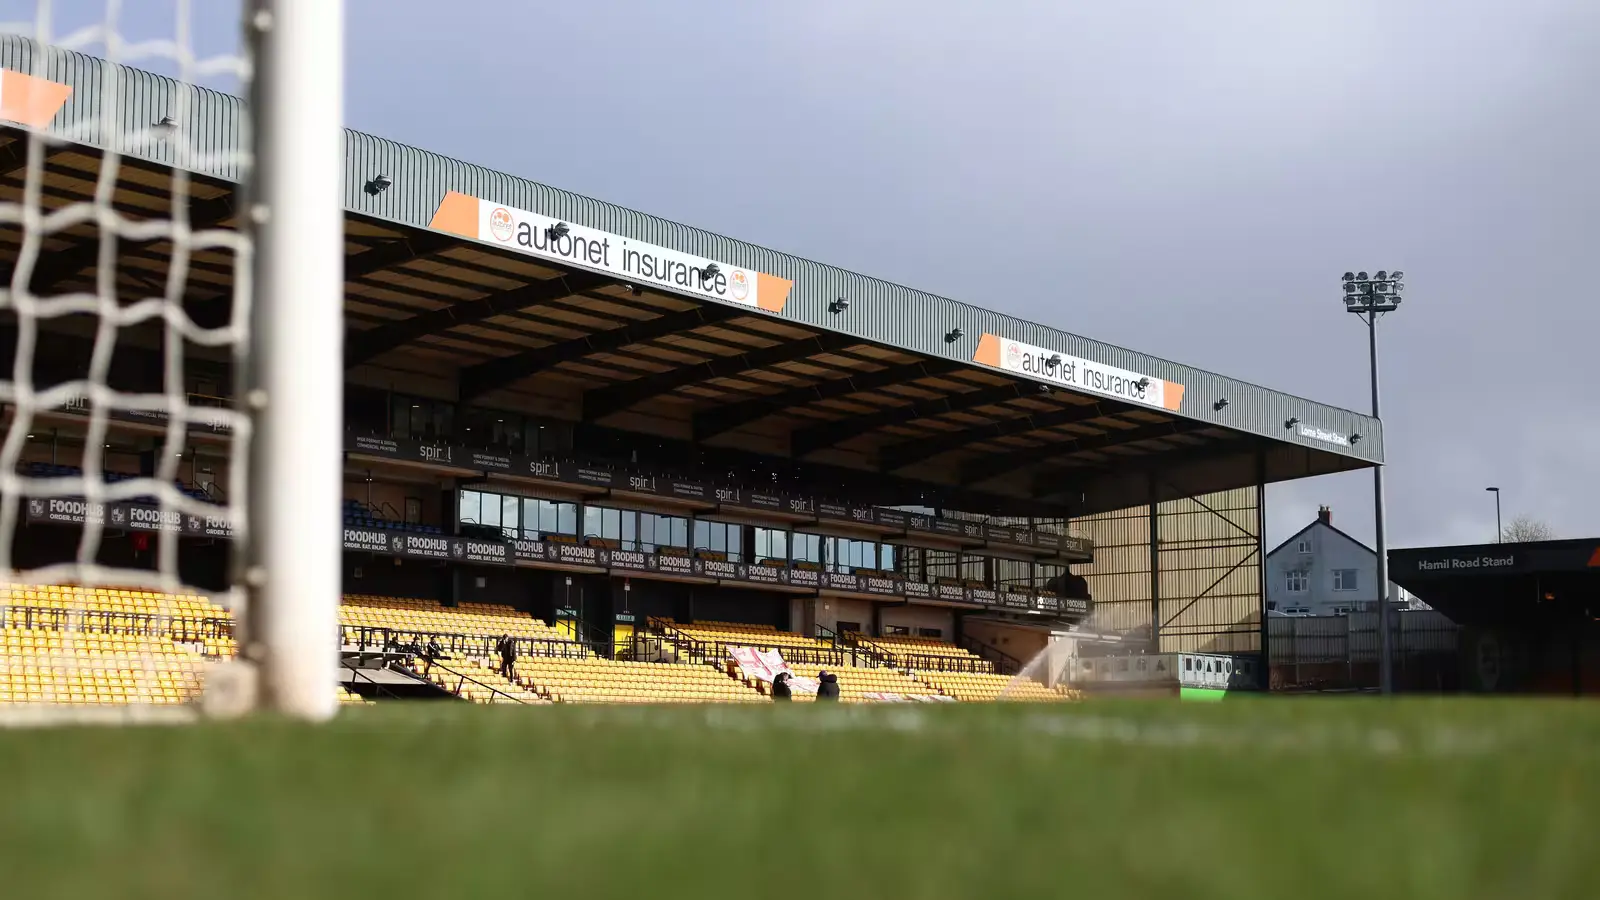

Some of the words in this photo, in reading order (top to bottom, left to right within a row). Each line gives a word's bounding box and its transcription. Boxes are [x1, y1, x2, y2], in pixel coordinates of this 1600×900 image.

[517, 221, 610, 266] autonet
[623, 241, 726, 294] insurance
[1022, 352, 1076, 383] autonet
[1084, 362, 1145, 399] insurance
[420, 444, 452, 460] spirl
[530, 460, 559, 476] spirl
[630, 475, 656, 490] spirl
[716, 488, 740, 501] spirl
[790, 496, 814, 512] spirl
[852, 508, 874, 520] spirl
[910, 516, 930, 528] spirl
[344, 530, 387, 544] FOODHUB
[408, 536, 448, 550] FOODHUB
[467, 542, 505, 556] FOODHUB
[561, 545, 595, 558] FOODHUB
[612, 550, 644, 564] FOODHUB
[660, 555, 690, 568] FOODHUB
[1418, 559, 1450, 570] Hamil
[1452, 557, 1480, 568] Road
[1482, 556, 1514, 567] Stand
[705, 560, 734, 572] FOODHUB
[749, 565, 777, 577] FOODHUB
[790, 570, 818, 580] FOODHUB
[830, 573, 856, 584] FOODHUB
[868, 578, 894, 588] FOODHUB
[905, 582, 928, 592] FOODHUB
